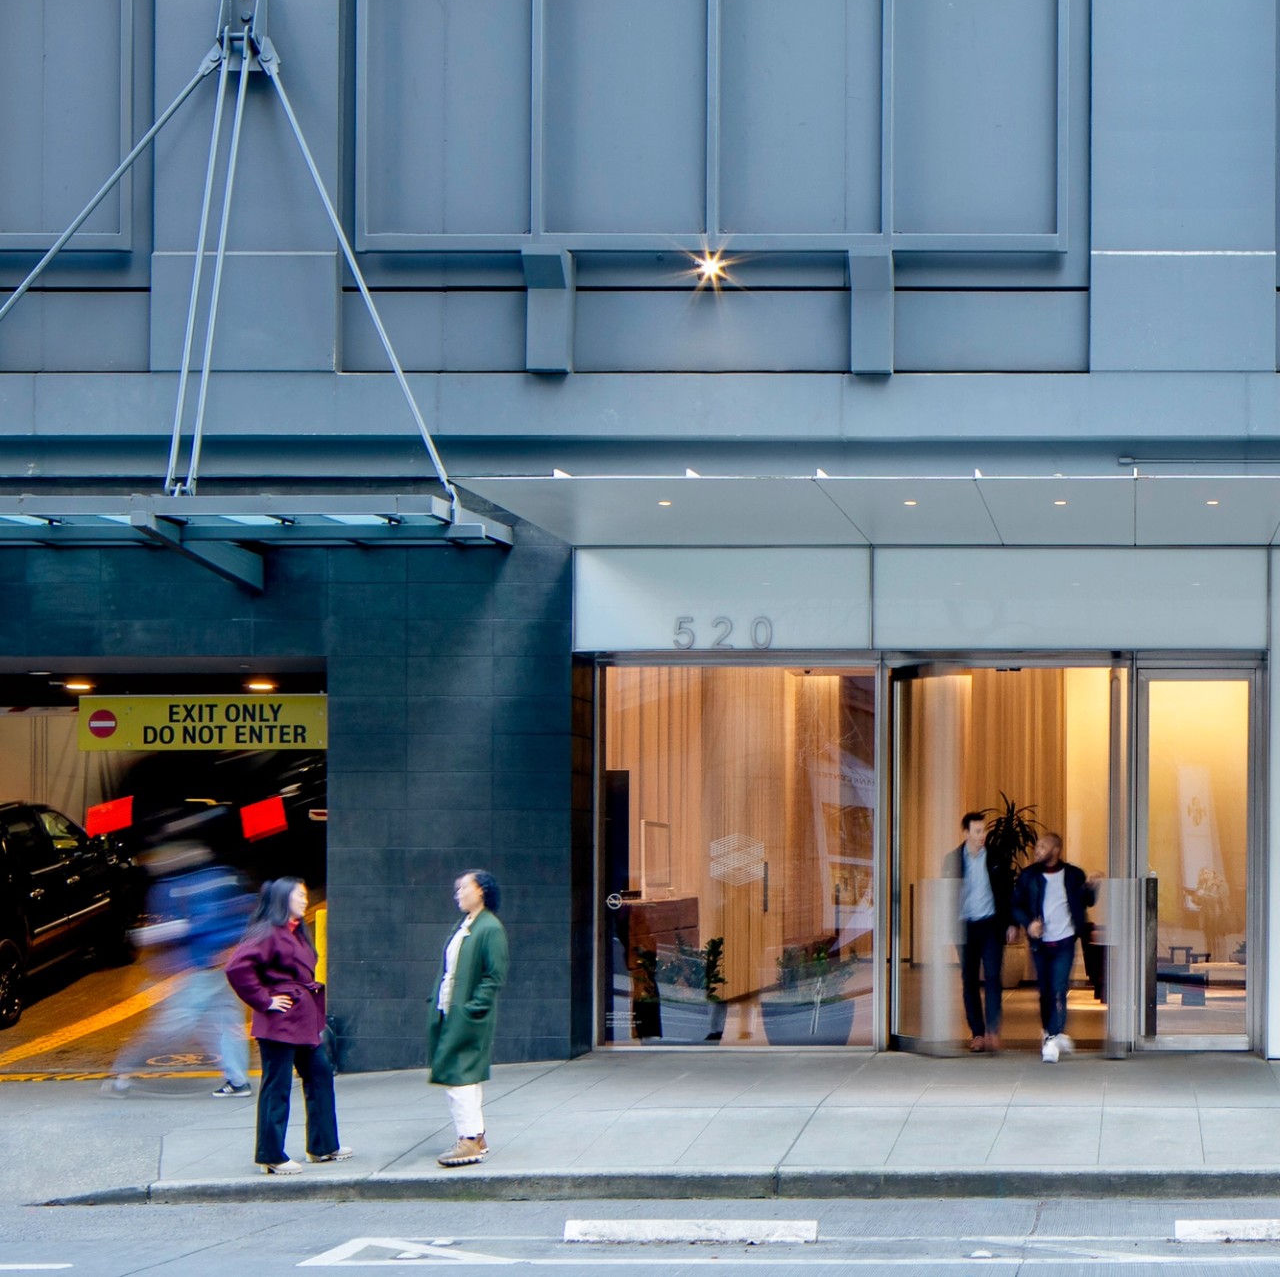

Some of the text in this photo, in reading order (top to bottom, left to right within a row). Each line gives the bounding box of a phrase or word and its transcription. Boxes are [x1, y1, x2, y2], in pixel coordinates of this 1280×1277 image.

[672, 616, 773, 650] 520
[168, 703, 283, 723] EXIT ONLY
[143, 725, 306, 744] DO NOT ENTER
